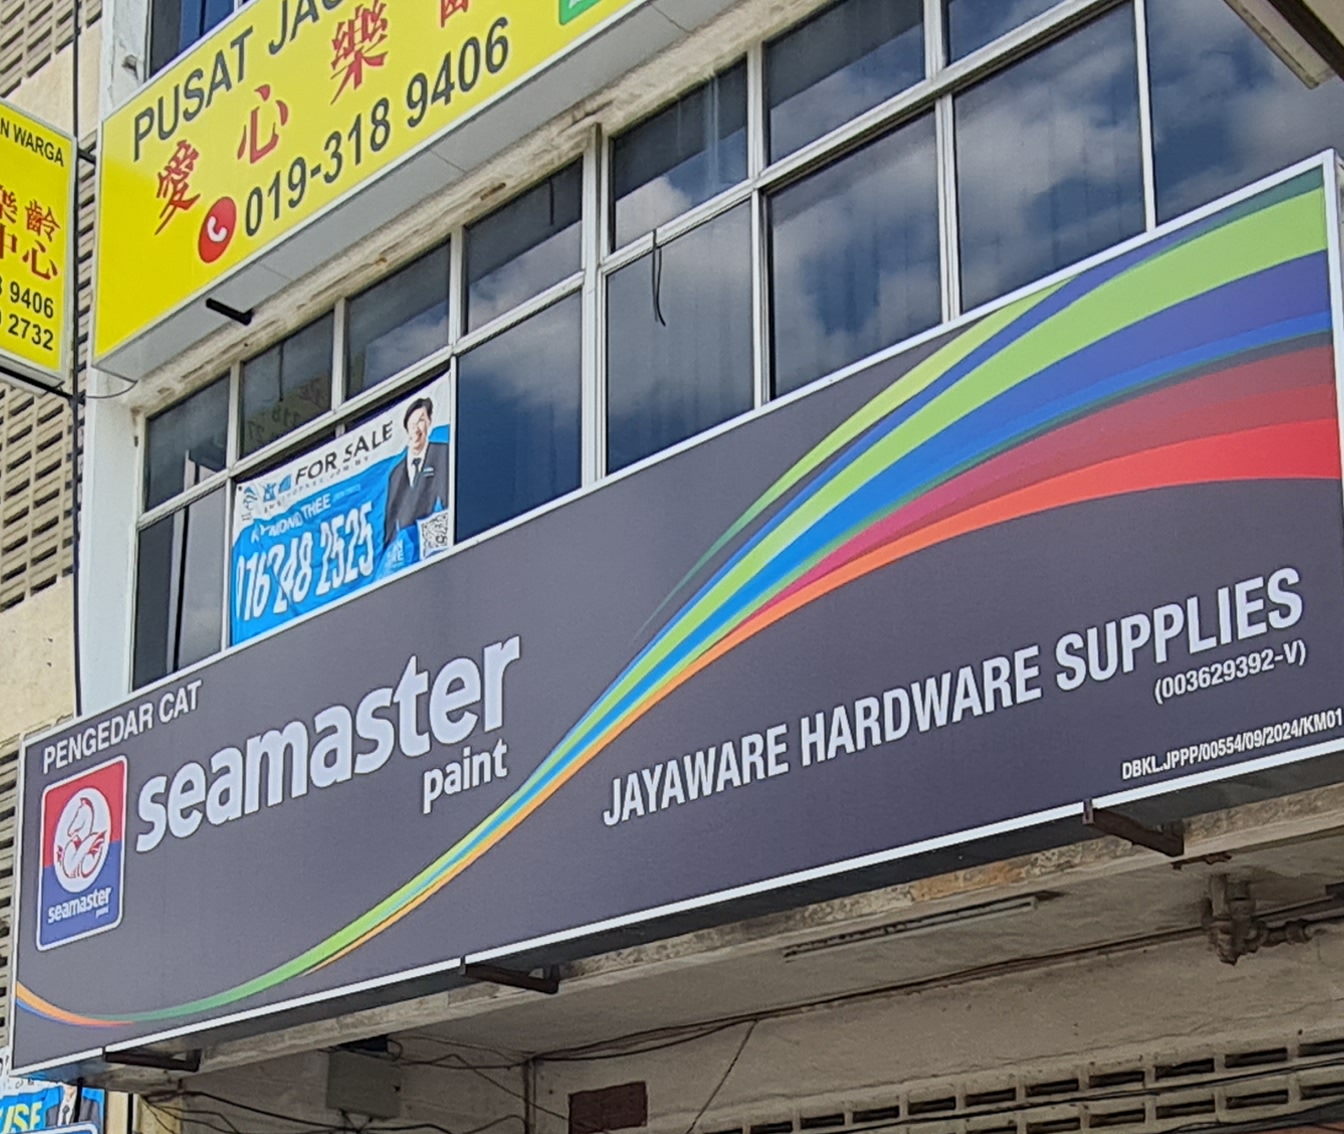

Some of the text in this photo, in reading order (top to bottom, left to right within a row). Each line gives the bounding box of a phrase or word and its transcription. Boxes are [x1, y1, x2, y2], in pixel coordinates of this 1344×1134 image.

[134, 26, 253, 161] PUSAT
[245, 17, 509, 237] 019-318 9406
[13, 123, 64, 168] WARGA
[8, 313, 54, 351] 2732
[9, 281, 54, 320] 9406
[295, 450, 338, 486] FOR
[342, 420, 394, 462] SALE
[300, 492, 331, 521] THEE
[268, 532, 313, 614] 248
[315, 501, 375, 597] 2525
[602, 566, 1305, 827] JAYAWARE HARDWARE SUPPLIES
[1153, 638, 1308, 705] (003629392-V)
[42, 679, 202, 775] PENGEDAR CAT
[135, 636, 521, 854] seamaster
[1121, 707, 1344, 780] DBKL.JPPP/00554/09/2024/KM01
[422, 739, 509, 815] paint
[48, 886, 113, 924] seamaster
